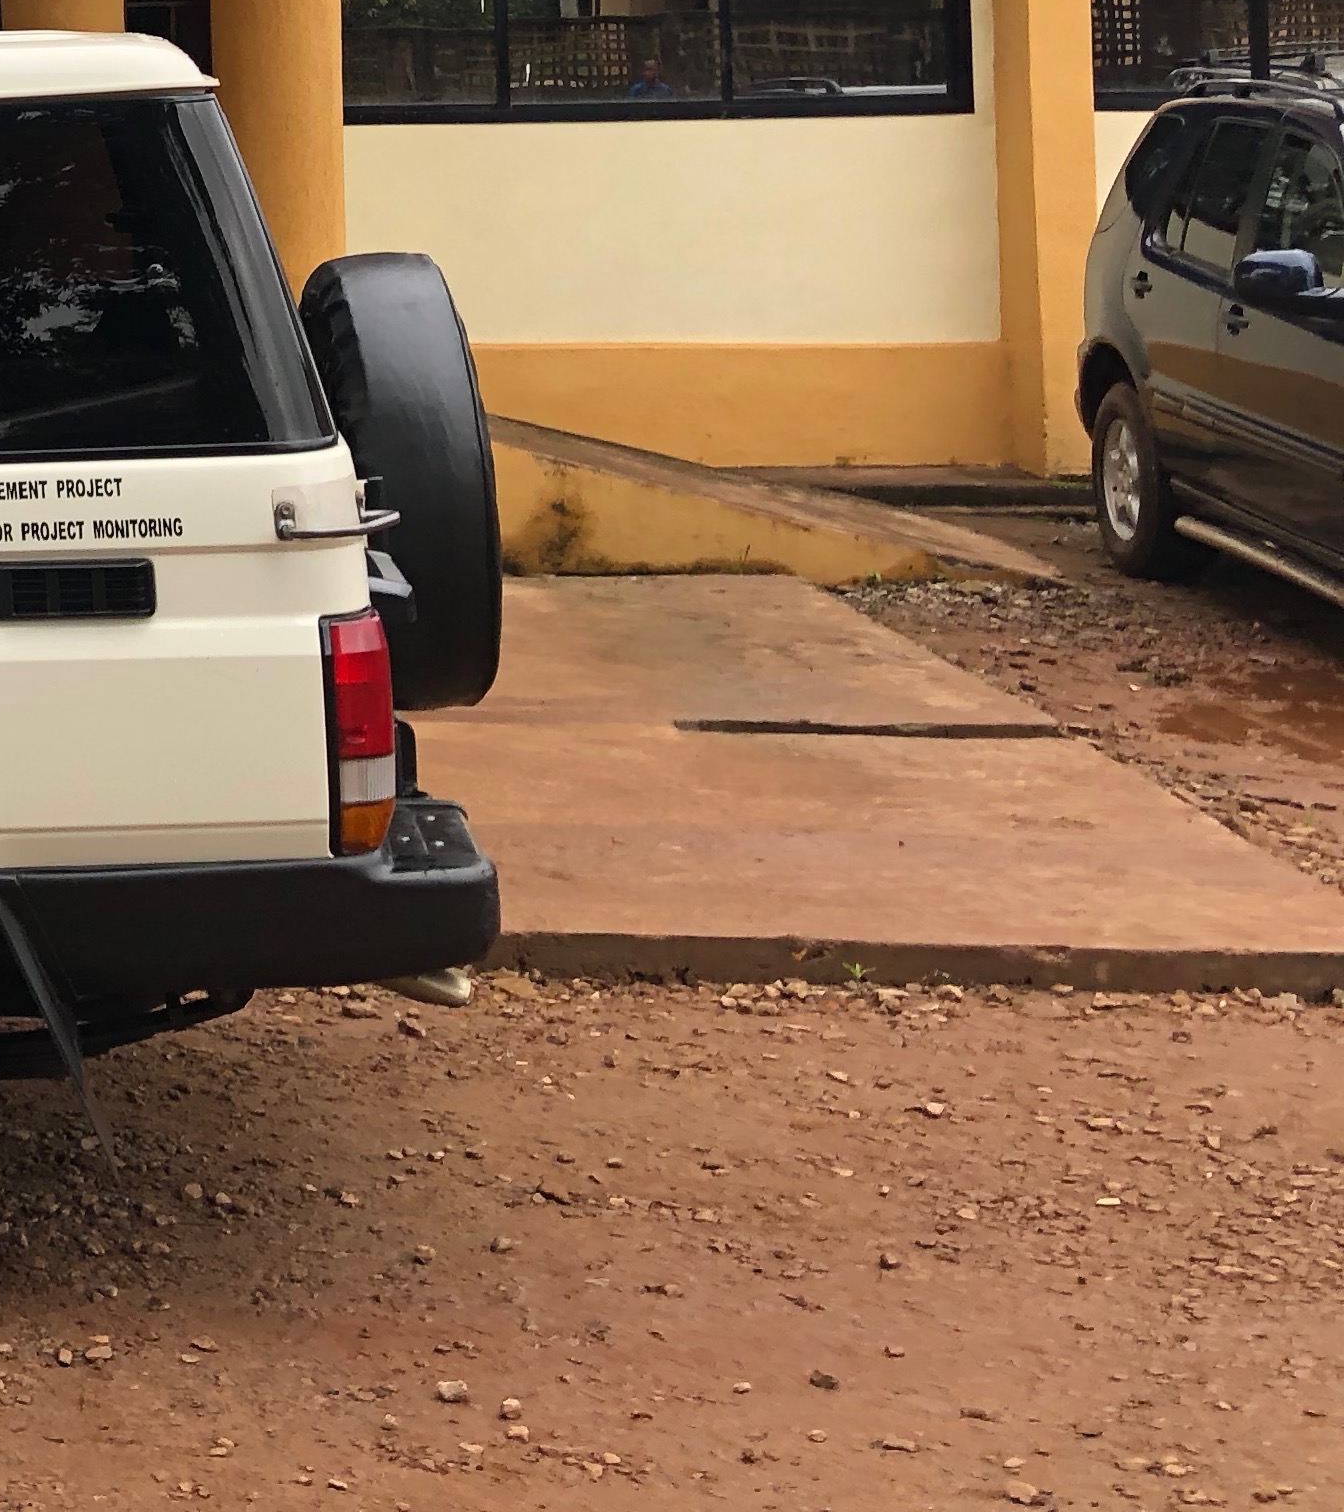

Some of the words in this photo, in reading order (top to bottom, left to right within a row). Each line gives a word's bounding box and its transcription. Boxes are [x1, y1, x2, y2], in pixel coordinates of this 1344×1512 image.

[56, 478, 123, 498] PROJECT
[21, 521, 84, 541] PROJECT
[93, 518, 183, 539] MONITORING
